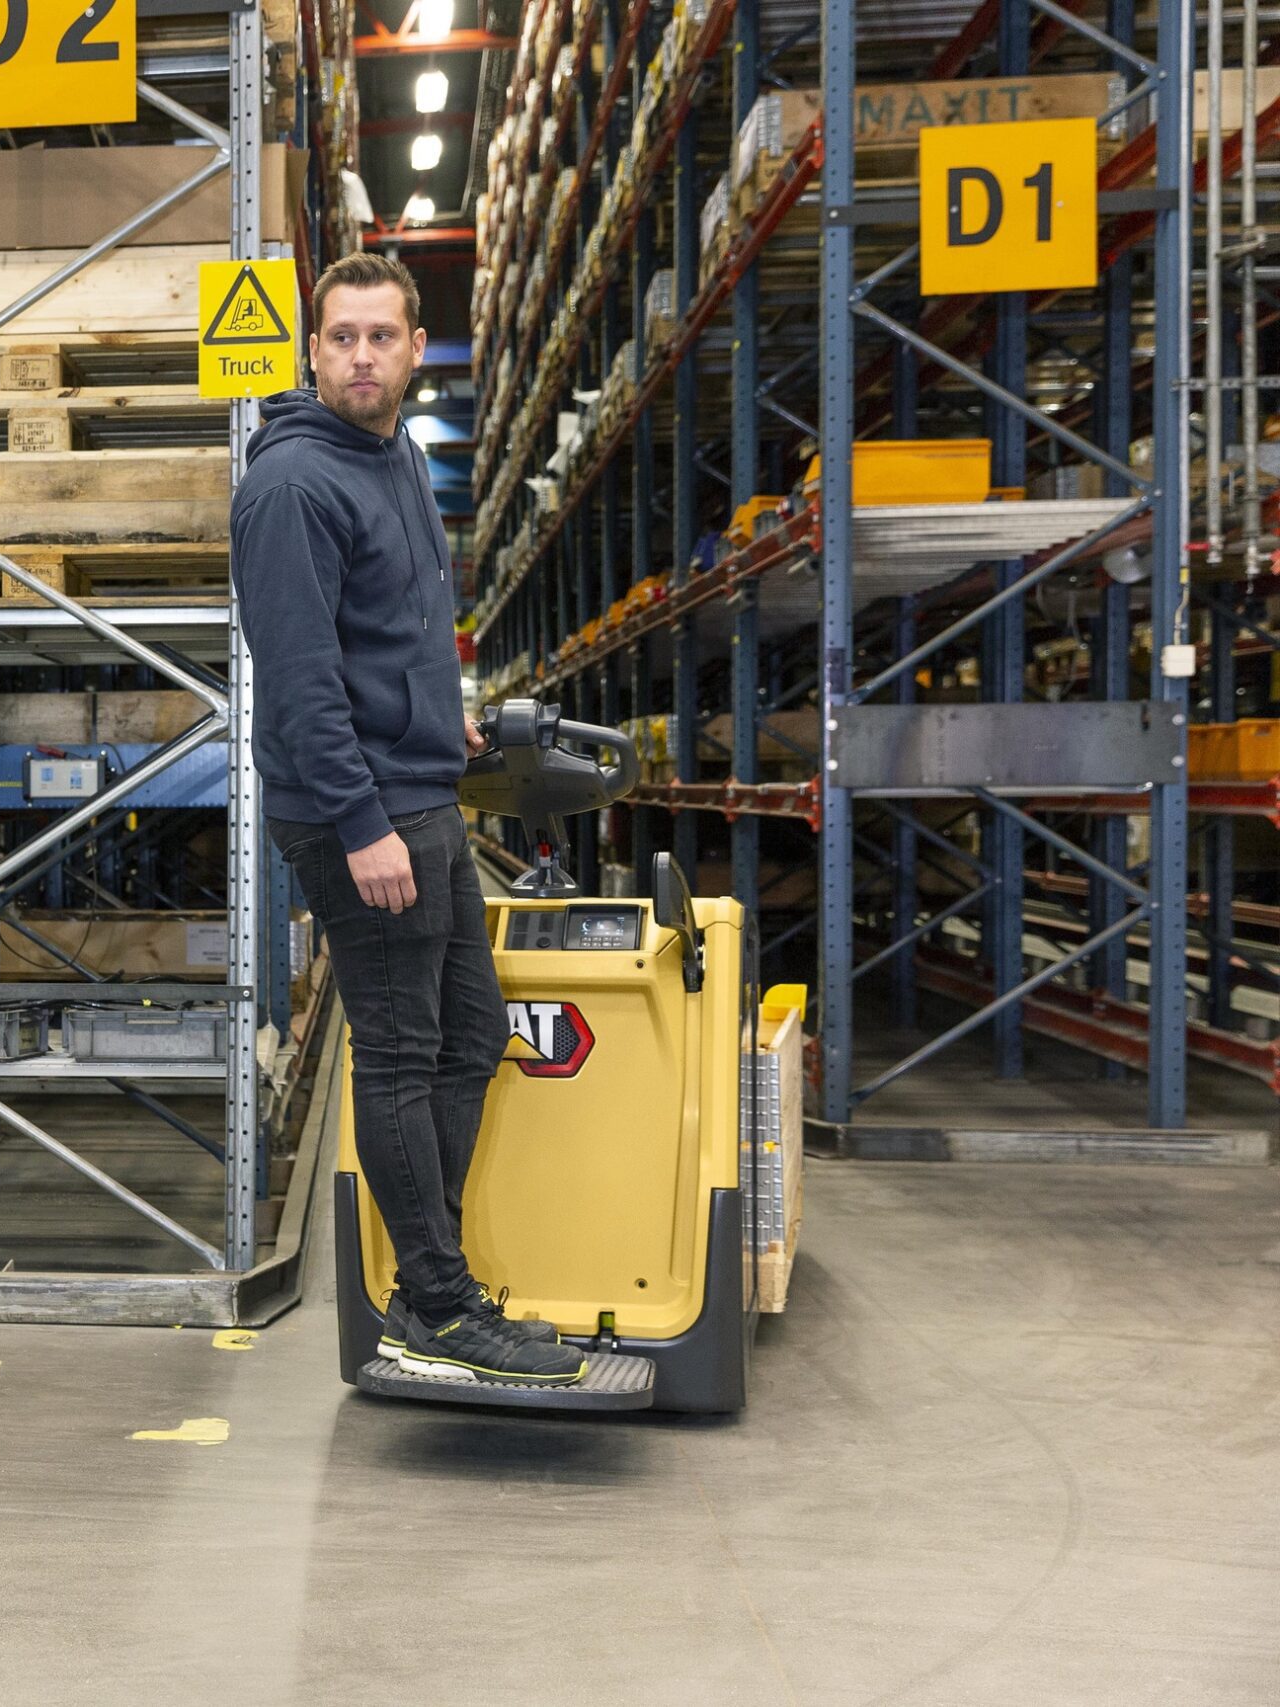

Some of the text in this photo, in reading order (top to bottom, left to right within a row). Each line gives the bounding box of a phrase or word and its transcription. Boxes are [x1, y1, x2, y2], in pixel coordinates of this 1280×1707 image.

[858, 84, 1032, 133] MAXIT
[946, 162, 1053, 248] D1
[218, 355, 274, 376] Truck
[506, 1002, 562, 1060] AT
